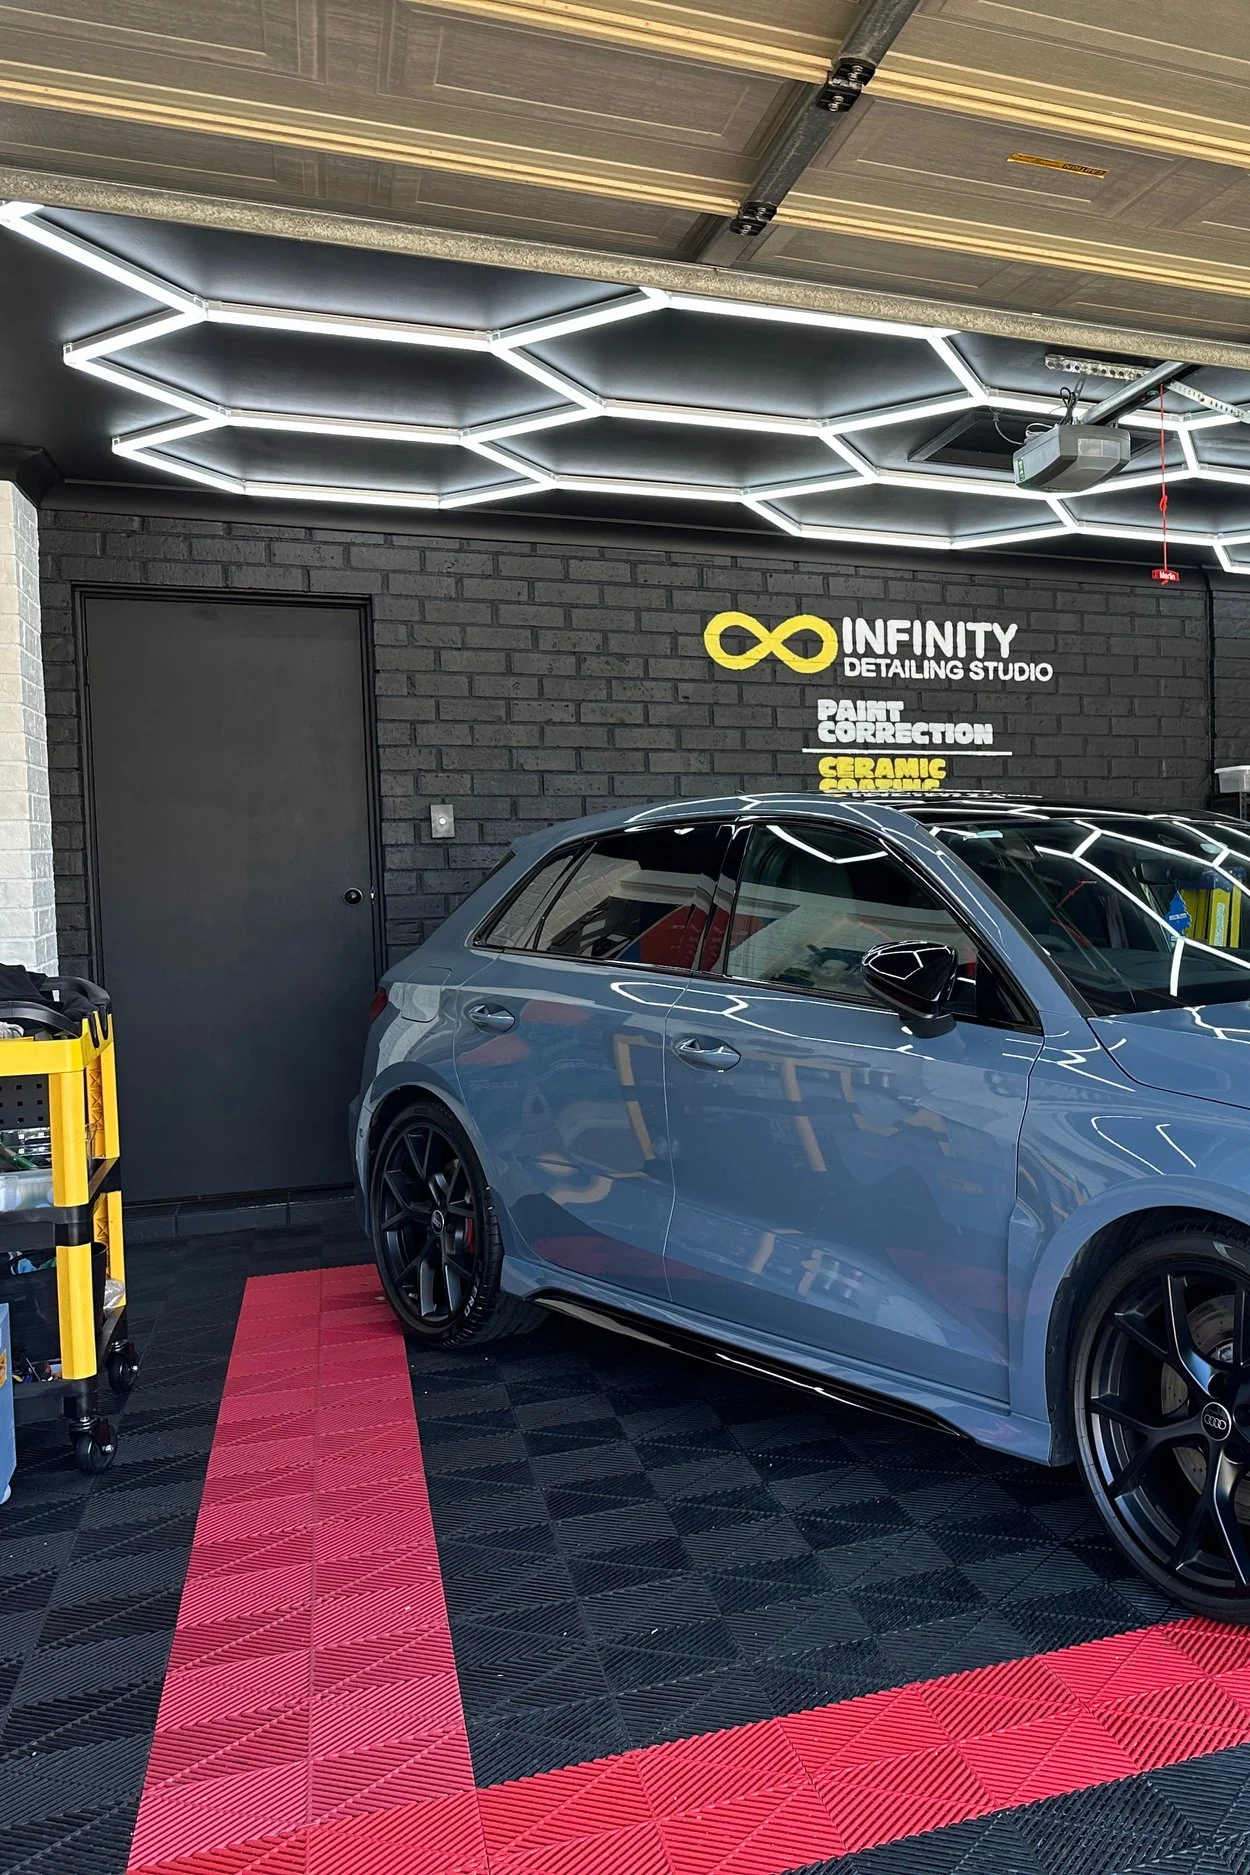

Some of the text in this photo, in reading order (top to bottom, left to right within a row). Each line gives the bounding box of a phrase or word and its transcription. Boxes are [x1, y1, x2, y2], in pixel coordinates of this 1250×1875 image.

[1063, 163, 1104, 175] CAUTION
[842, 617, 1018, 659] INFINITY
[844, 656, 1053, 682] DETAILING STUDIO
[817, 699, 904, 722] PAINT
[817, 721, 993, 745] CORRECTION
[818, 756, 947, 780] CERAMIC
